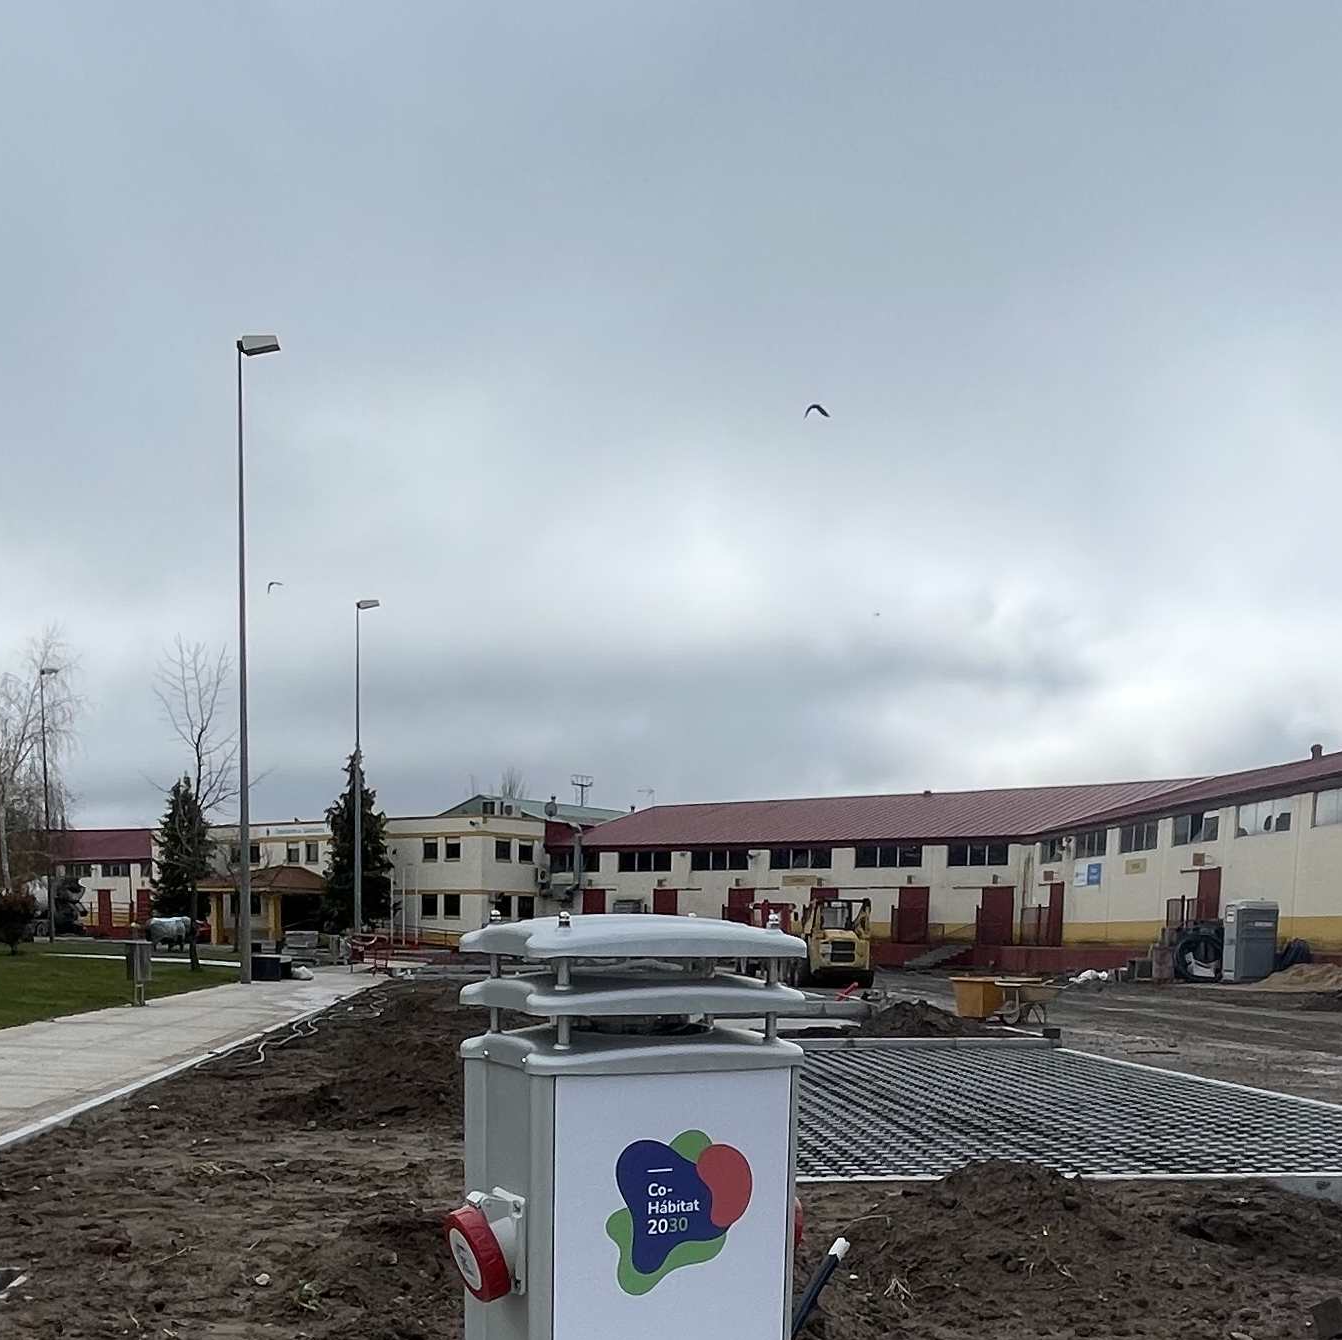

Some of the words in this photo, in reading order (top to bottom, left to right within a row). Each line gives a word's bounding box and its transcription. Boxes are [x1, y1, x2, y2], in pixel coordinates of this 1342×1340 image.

[648, 1182, 673, 1198] Co-
[647, 1198, 700, 1215] Hábitat
[647, 1216, 688, 1234] 2030
